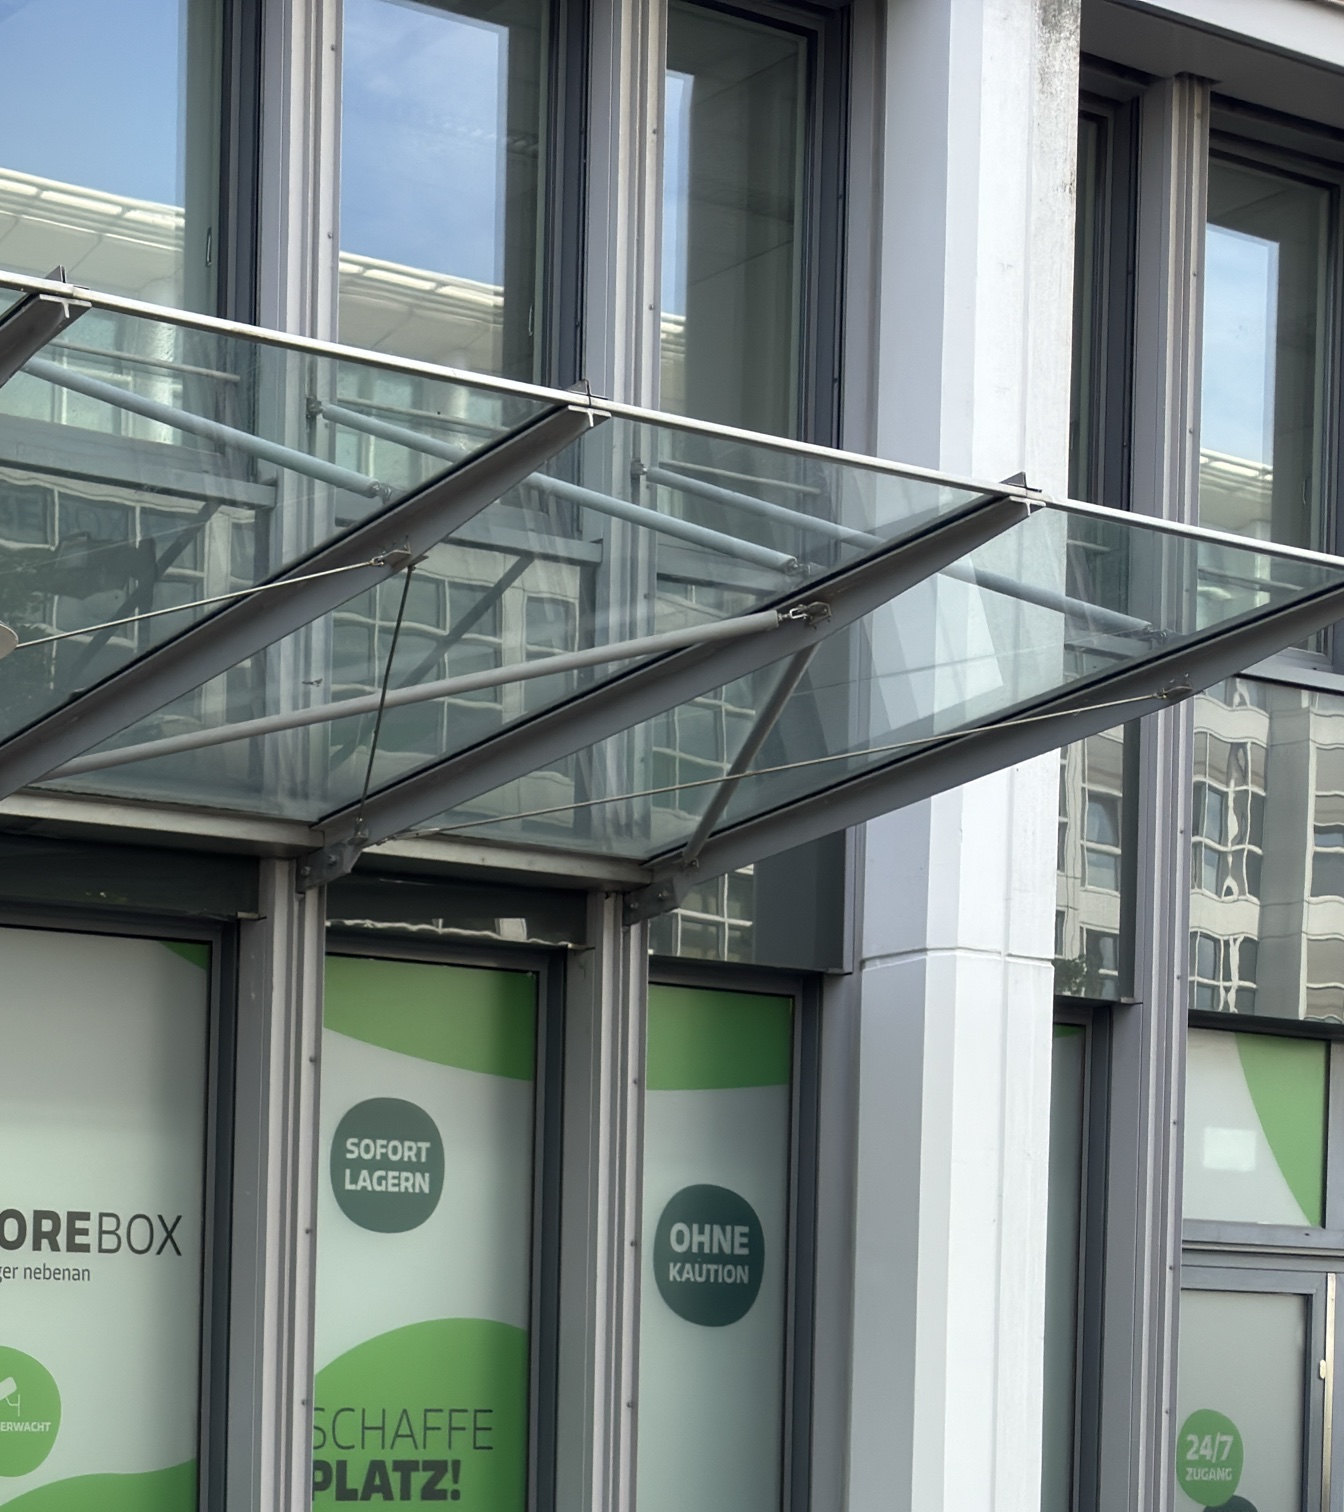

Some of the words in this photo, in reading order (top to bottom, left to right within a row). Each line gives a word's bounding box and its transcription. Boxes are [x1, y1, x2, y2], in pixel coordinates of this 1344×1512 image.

[345, 1137, 431, 1163] SOFORT
[344, 1169, 430, 1193] LAGERN
[669, 1222, 750, 1255] OHNE
[23, 1263, 91, 1282] nebenan
[668, 1262, 749, 1284] KAUTION
[312, 1407, 493, 1450] SCHAFFE
[1185, 1432, 1234, 1463] 24/7
[311, 1459, 461, 1501] PLATZ!
[1185, 1467, 1233, 1481] ZUGANG
